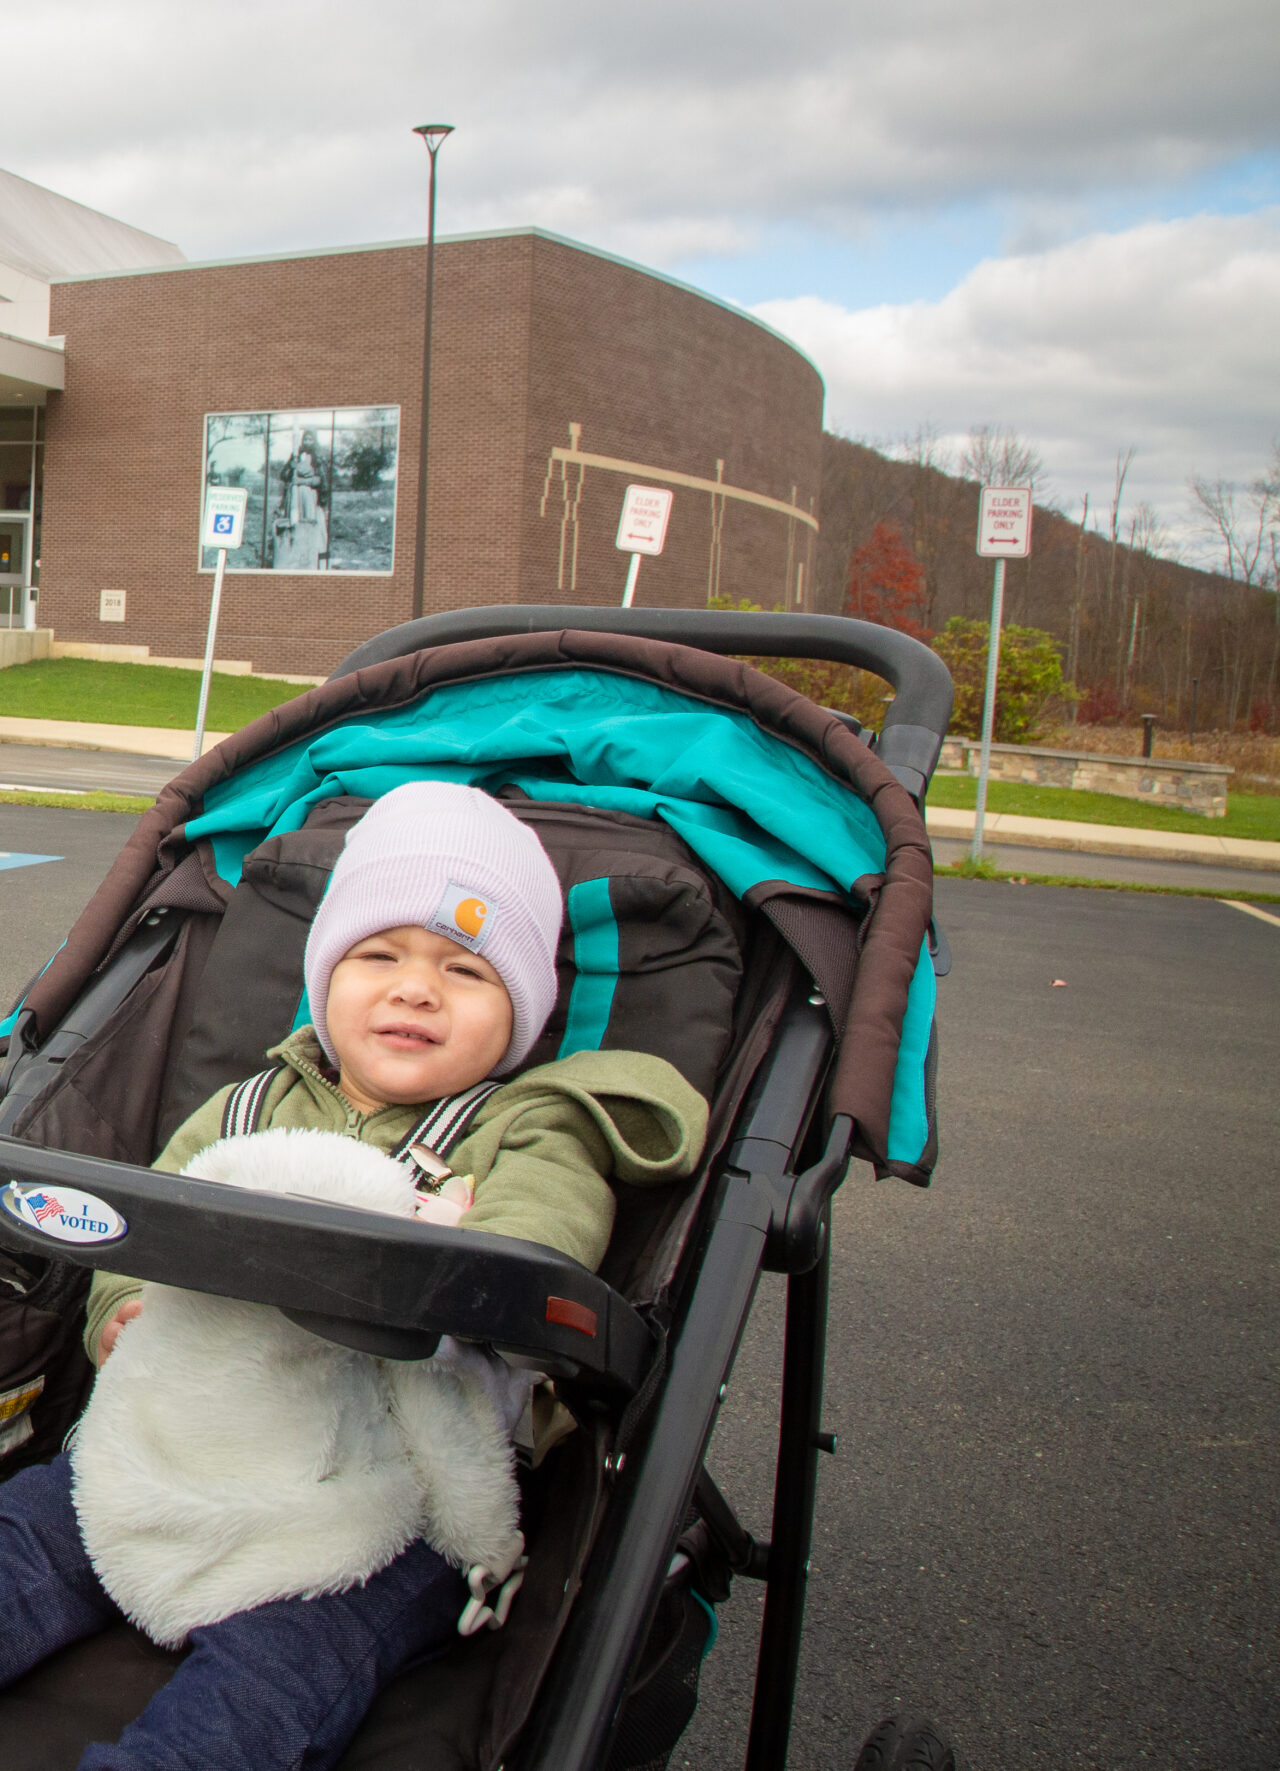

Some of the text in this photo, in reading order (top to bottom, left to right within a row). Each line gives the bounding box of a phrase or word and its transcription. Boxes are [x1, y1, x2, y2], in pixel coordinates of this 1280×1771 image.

[991, 497, 1020, 507] ELDER
[630, 506, 661, 519] PARKING
[987, 508, 1023, 520] PARKING
[633, 518, 653, 528] ONLY
[993, 520, 1015, 530] ONLY
[81, 1204, 88, 1216] I
[59, 1214, 109, 1234] VOTED
